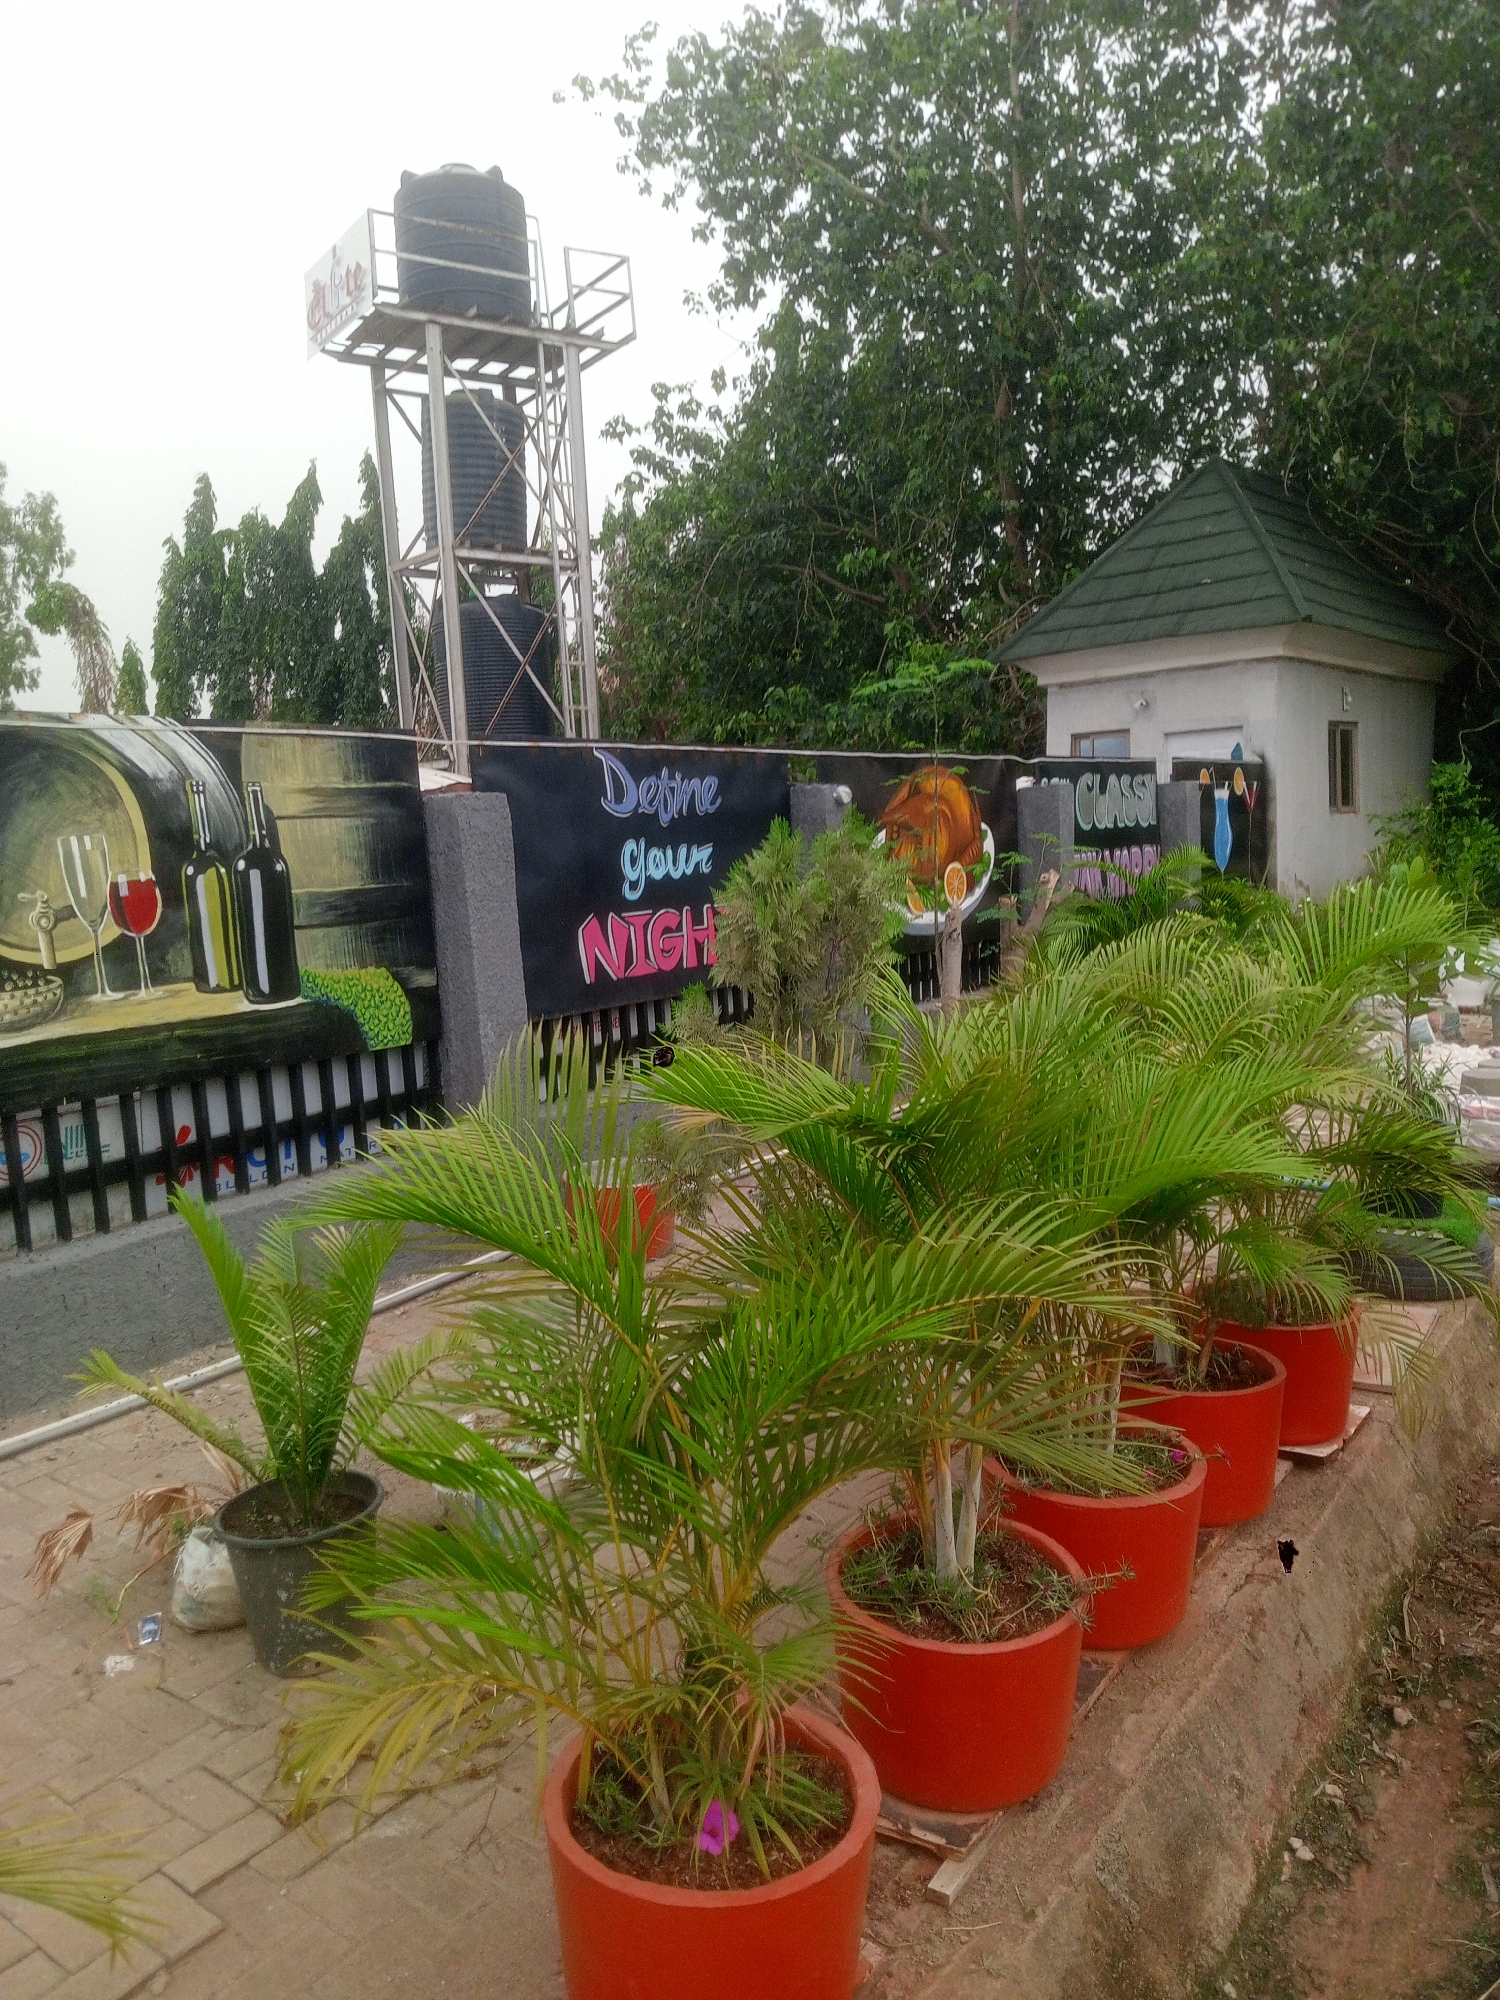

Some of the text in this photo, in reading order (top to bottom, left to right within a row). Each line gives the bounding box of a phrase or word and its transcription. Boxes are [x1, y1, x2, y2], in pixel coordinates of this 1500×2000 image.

[593, 747, 722, 828] Define
[621, 837, 714, 901] your
[578, 903, 726, 985] NIGH
